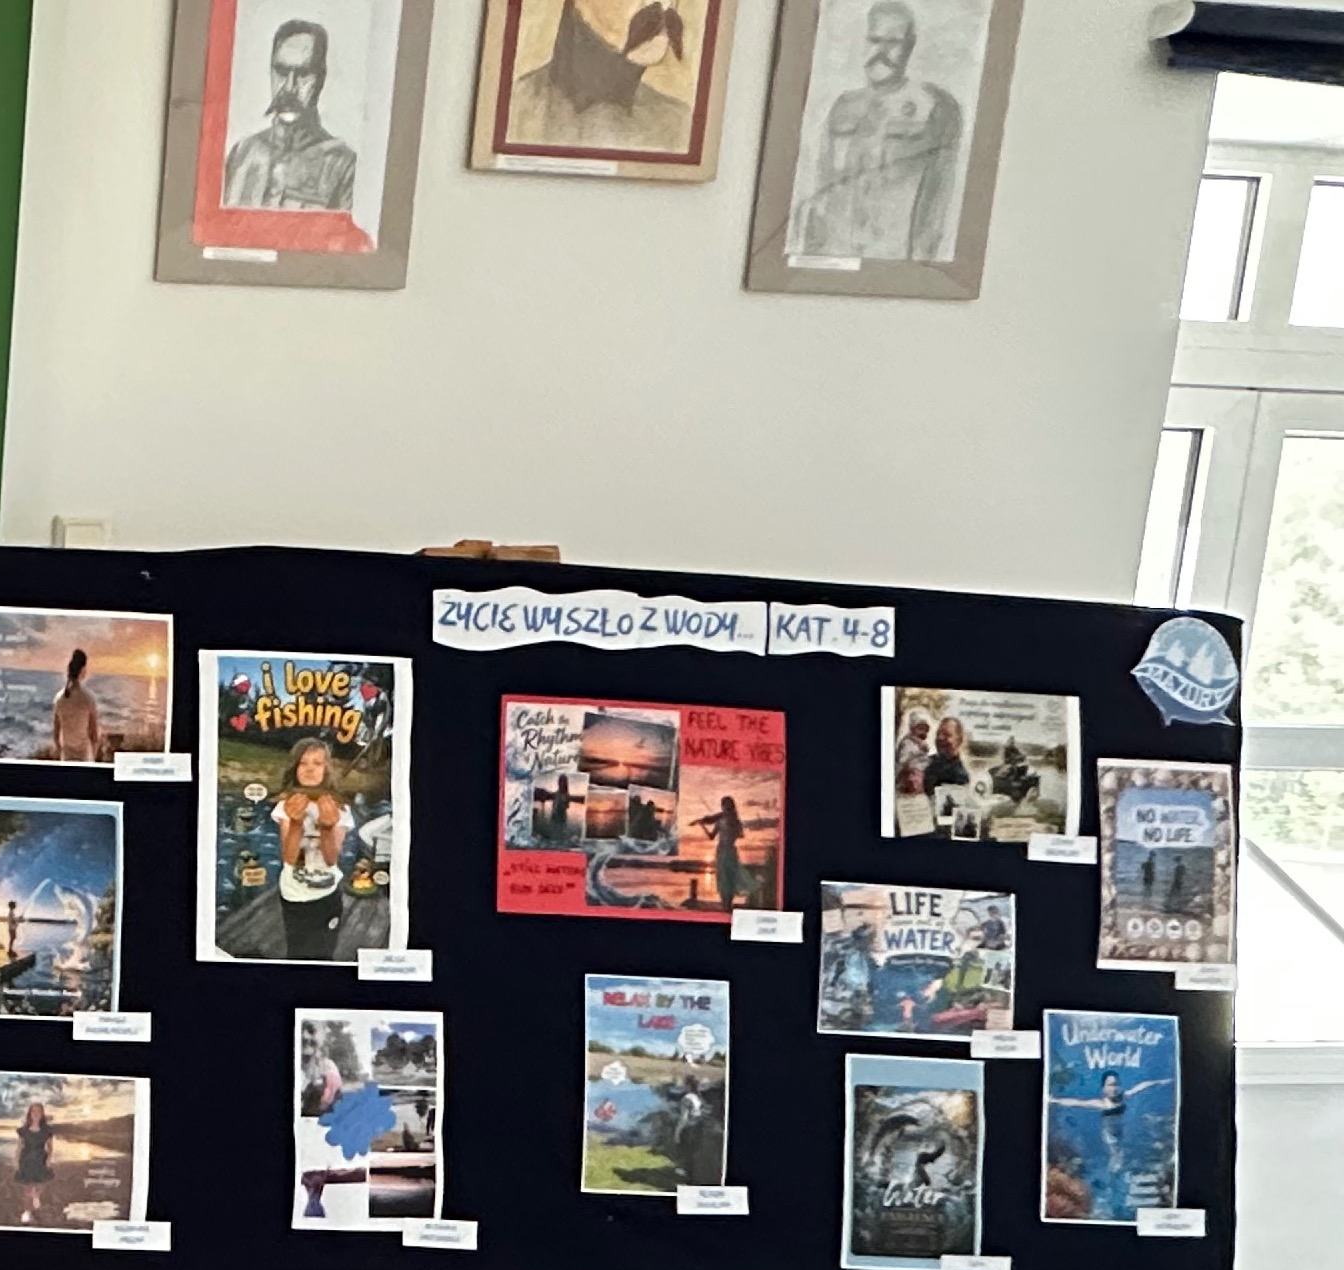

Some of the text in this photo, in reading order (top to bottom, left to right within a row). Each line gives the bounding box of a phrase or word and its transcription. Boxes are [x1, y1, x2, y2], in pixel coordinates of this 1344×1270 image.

[438, 594, 517, 635] ŻYCIE
[523, 604, 633, 638] WYSZŁO
[640, 607, 657, 632] Z
[843, 618, 890, 648] 4-8
[260, 660, 351, 696] i love
[1148, 666, 1224, 709] MAZURY
[254, 694, 363, 743] fishing
[516, 708, 555, 729] Catch
[687, 711, 770, 735] FEEL THE
[684, 738, 740, 762] NATURE
[1136, 808, 1156, 824] NO
[1143, 827, 1163, 843] NO
[889, 891, 942, 918] LIFE
[883, 928, 956, 954] WATER
[679, 994, 712, 1011] THE
[1062, 1023, 1164, 1047] Underwater
[1083, 1046, 1143, 1070] World
